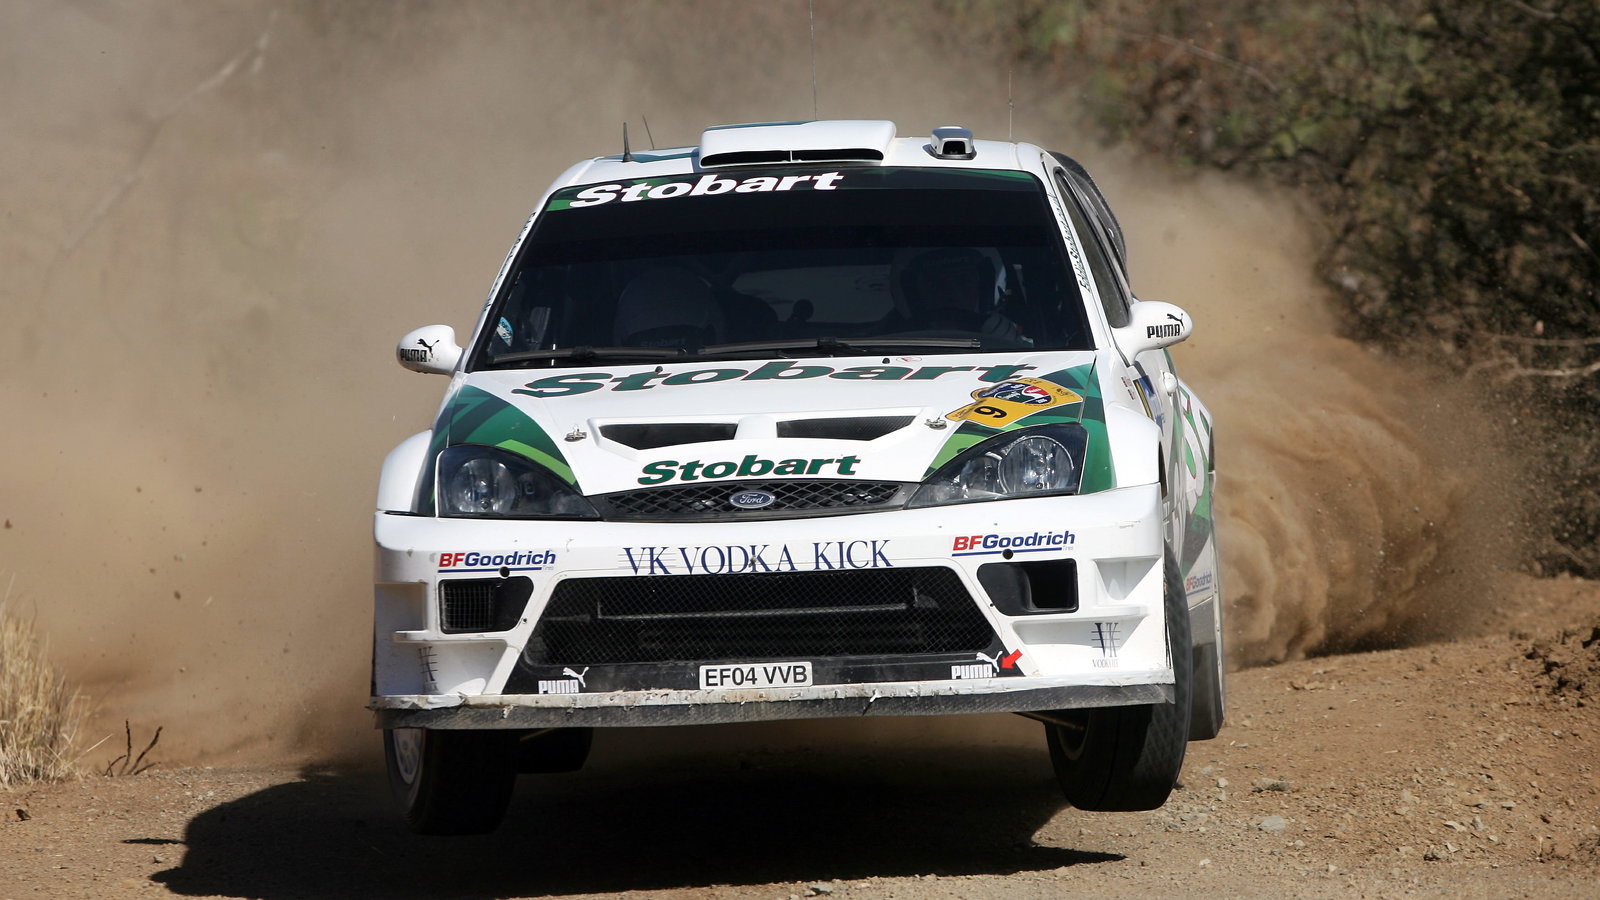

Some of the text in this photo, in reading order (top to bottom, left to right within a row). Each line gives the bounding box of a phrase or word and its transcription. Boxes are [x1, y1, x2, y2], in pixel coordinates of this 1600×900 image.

[569, 171, 844, 208] Stobart
[1146, 323, 1181, 338] PUMA
[400, 348, 428, 362] PUMA
[512, 361, 1037, 397] Stobart
[637, 455, 861, 485] Stobart
[739, 493, 764, 505] Ford
[952, 531, 1076, 551] BFGoodrich
[438, 550, 556, 567] BFGoodrich
[622, 539, 894, 576] VK VODKA KICK
[1093, 622, 1119, 658] VK
[705, 665, 808, 687] EF04 VVB
[951, 664, 993, 679] PUMA
[538, 680, 580, 694] PUMA
